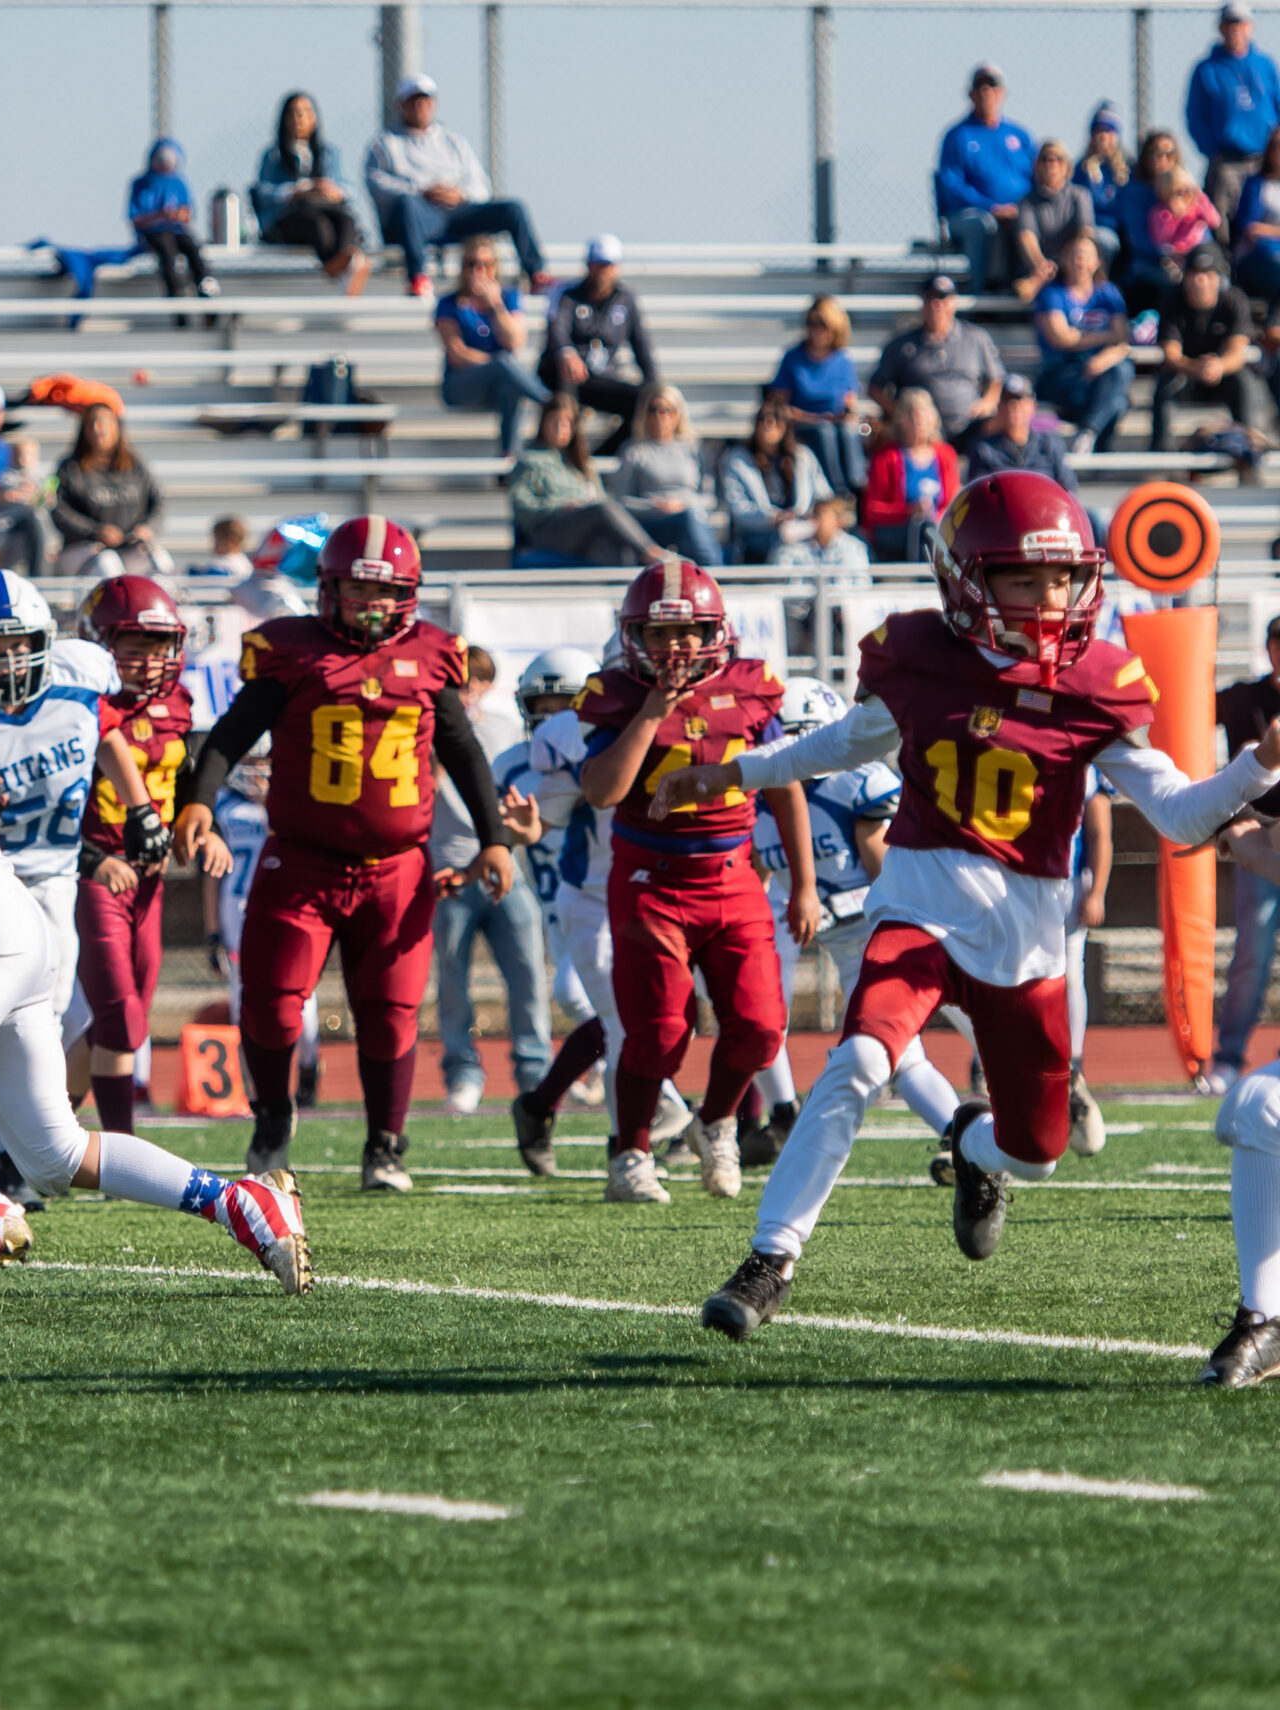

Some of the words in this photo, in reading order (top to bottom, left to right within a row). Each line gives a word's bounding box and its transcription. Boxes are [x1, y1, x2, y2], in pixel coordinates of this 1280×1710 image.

[309, 704, 422, 808] 84
[926, 740, 1039, 841] 10
[198, 1039, 233, 1099] 3
